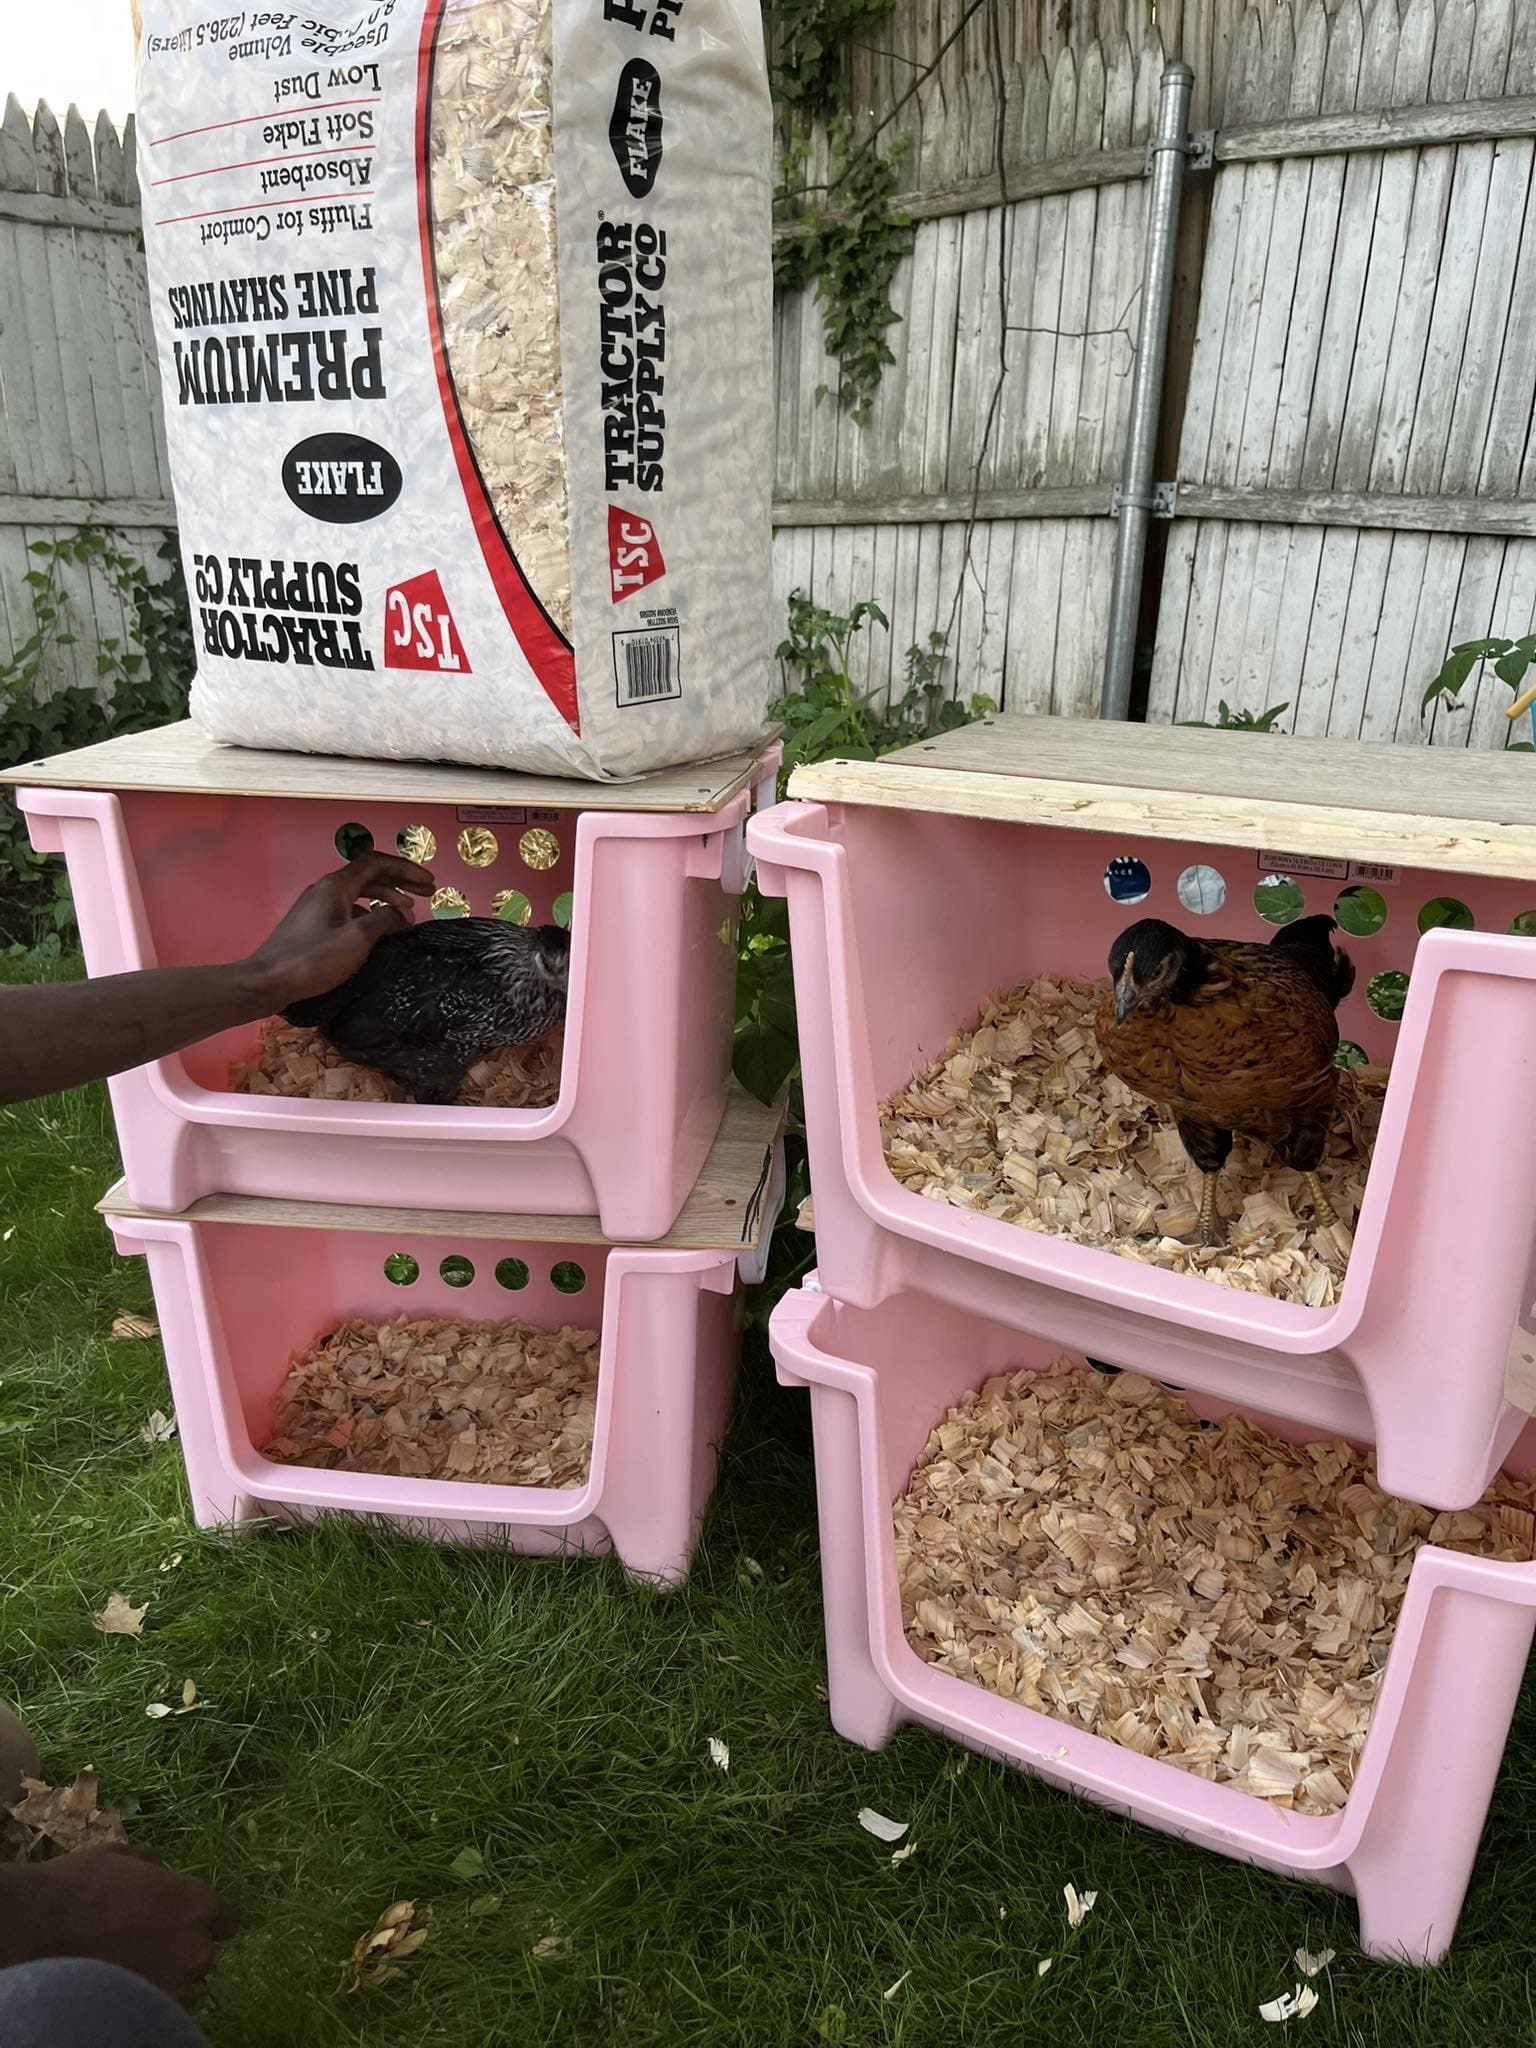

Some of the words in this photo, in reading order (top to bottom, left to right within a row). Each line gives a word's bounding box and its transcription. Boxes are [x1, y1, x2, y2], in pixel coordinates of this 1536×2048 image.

[197, 12, 245, 46] (226.5
[251, 12, 298, 30] Feet
[649, 0, 684, 42] PI
[147, 29, 193, 59] Liters)
[228, 34, 292, 61] Volume
[301, 22, 388, 57] Useable
[274, 72, 321, 103] Dust
[327, 63, 382, 91] Low
[263, 118, 322, 149] Flake
[326, 110, 374, 141] Soft
[626, 77, 652, 180] FLAKE
[260, 157, 373, 194] Absorbent
[200, 215, 271, 245] Comfort
[276, 210, 304, 236] for
[309, 203, 373, 233] Fluffs
[168, 274, 289, 329] SHAVINGS
[294, 267, 379, 318] PINE
[173, 327, 387, 405] PREMIUM
[597, 221, 635, 491] TRACTOR
[636, 293, 665, 491] SUPPLY
[295, 461, 384, 495] FLAKE
[613, 523, 652, 592] TSC
[227, 557, 363, 616] SUPPLY
[200, 607, 376, 671] TRACTOR
[389, 590, 461, 670] TSC
